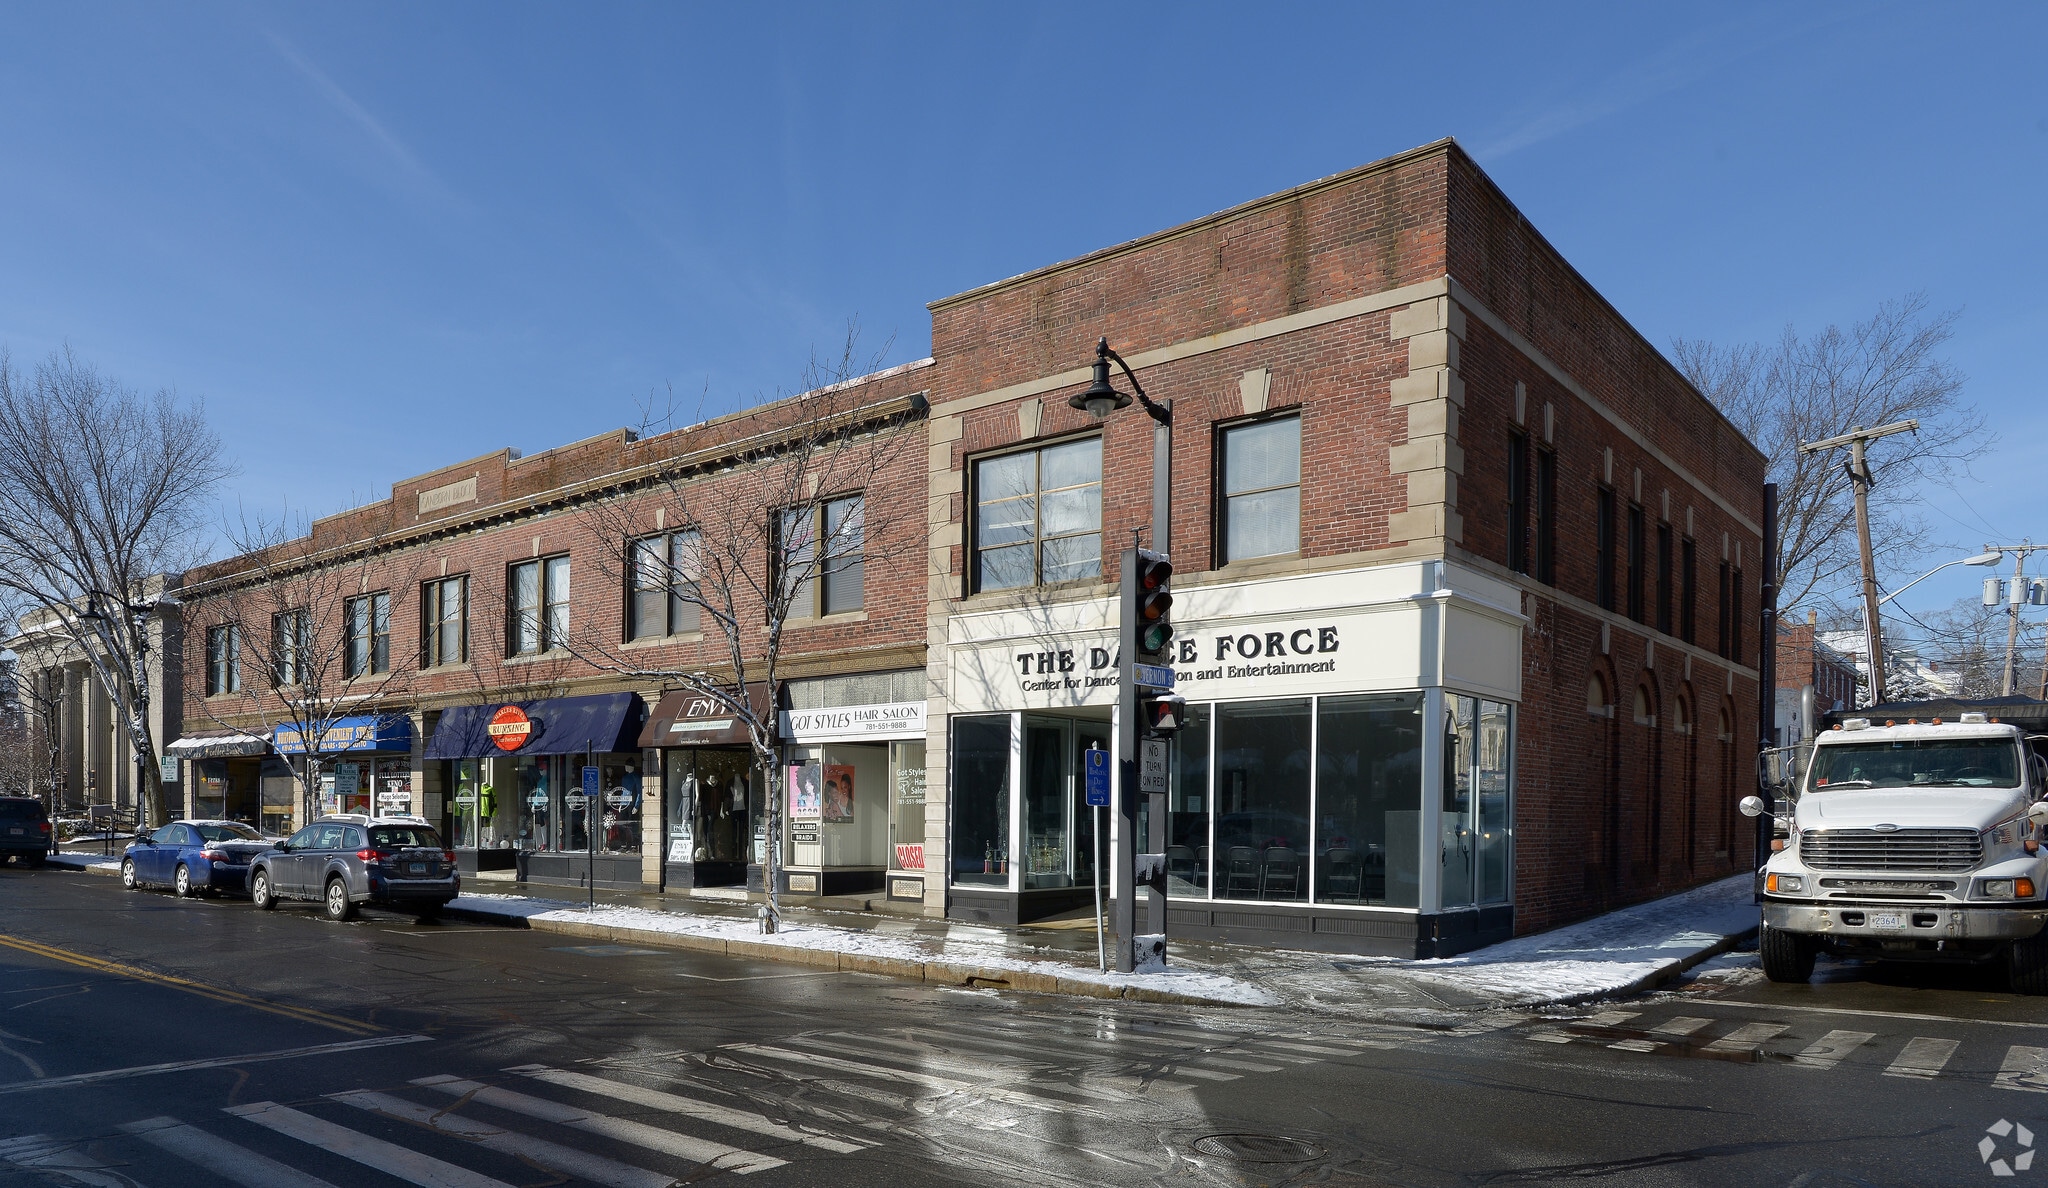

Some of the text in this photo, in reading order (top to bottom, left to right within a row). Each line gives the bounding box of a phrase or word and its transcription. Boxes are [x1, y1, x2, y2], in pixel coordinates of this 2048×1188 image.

[1017, 649, 1075, 675] THE
[1215, 626, 1340, 661] FORCE
[1197, 665, 1223, 680] and
[1227, 659, 1336, 679] Entertainment
[1142, 667, 1166, 686] VERNON
[1022, 677, 1062, 692] Center
[1064, 677, 1082, 689] for
[790, 706, 918, 731] GOT STYLES HAIR SALON
[492, 723, 525, 734] RUNNING
[865, 721, 907, 731] 781-551-9888
[1148, 746, 1159, 757] NO
[896, 768, 908, 777] Got
[1146, 762, 1161, 772] TURN
[387, 780, 402, 788] KENO
[1142, 776, 1165, 787] ON RED
[392, 792, 409, 800] Selection
[897, 845, 925, 869] CLOSED
[1837, 880, 1938, 889] STERLING
[1875, 917, 1900, 925] 23641
